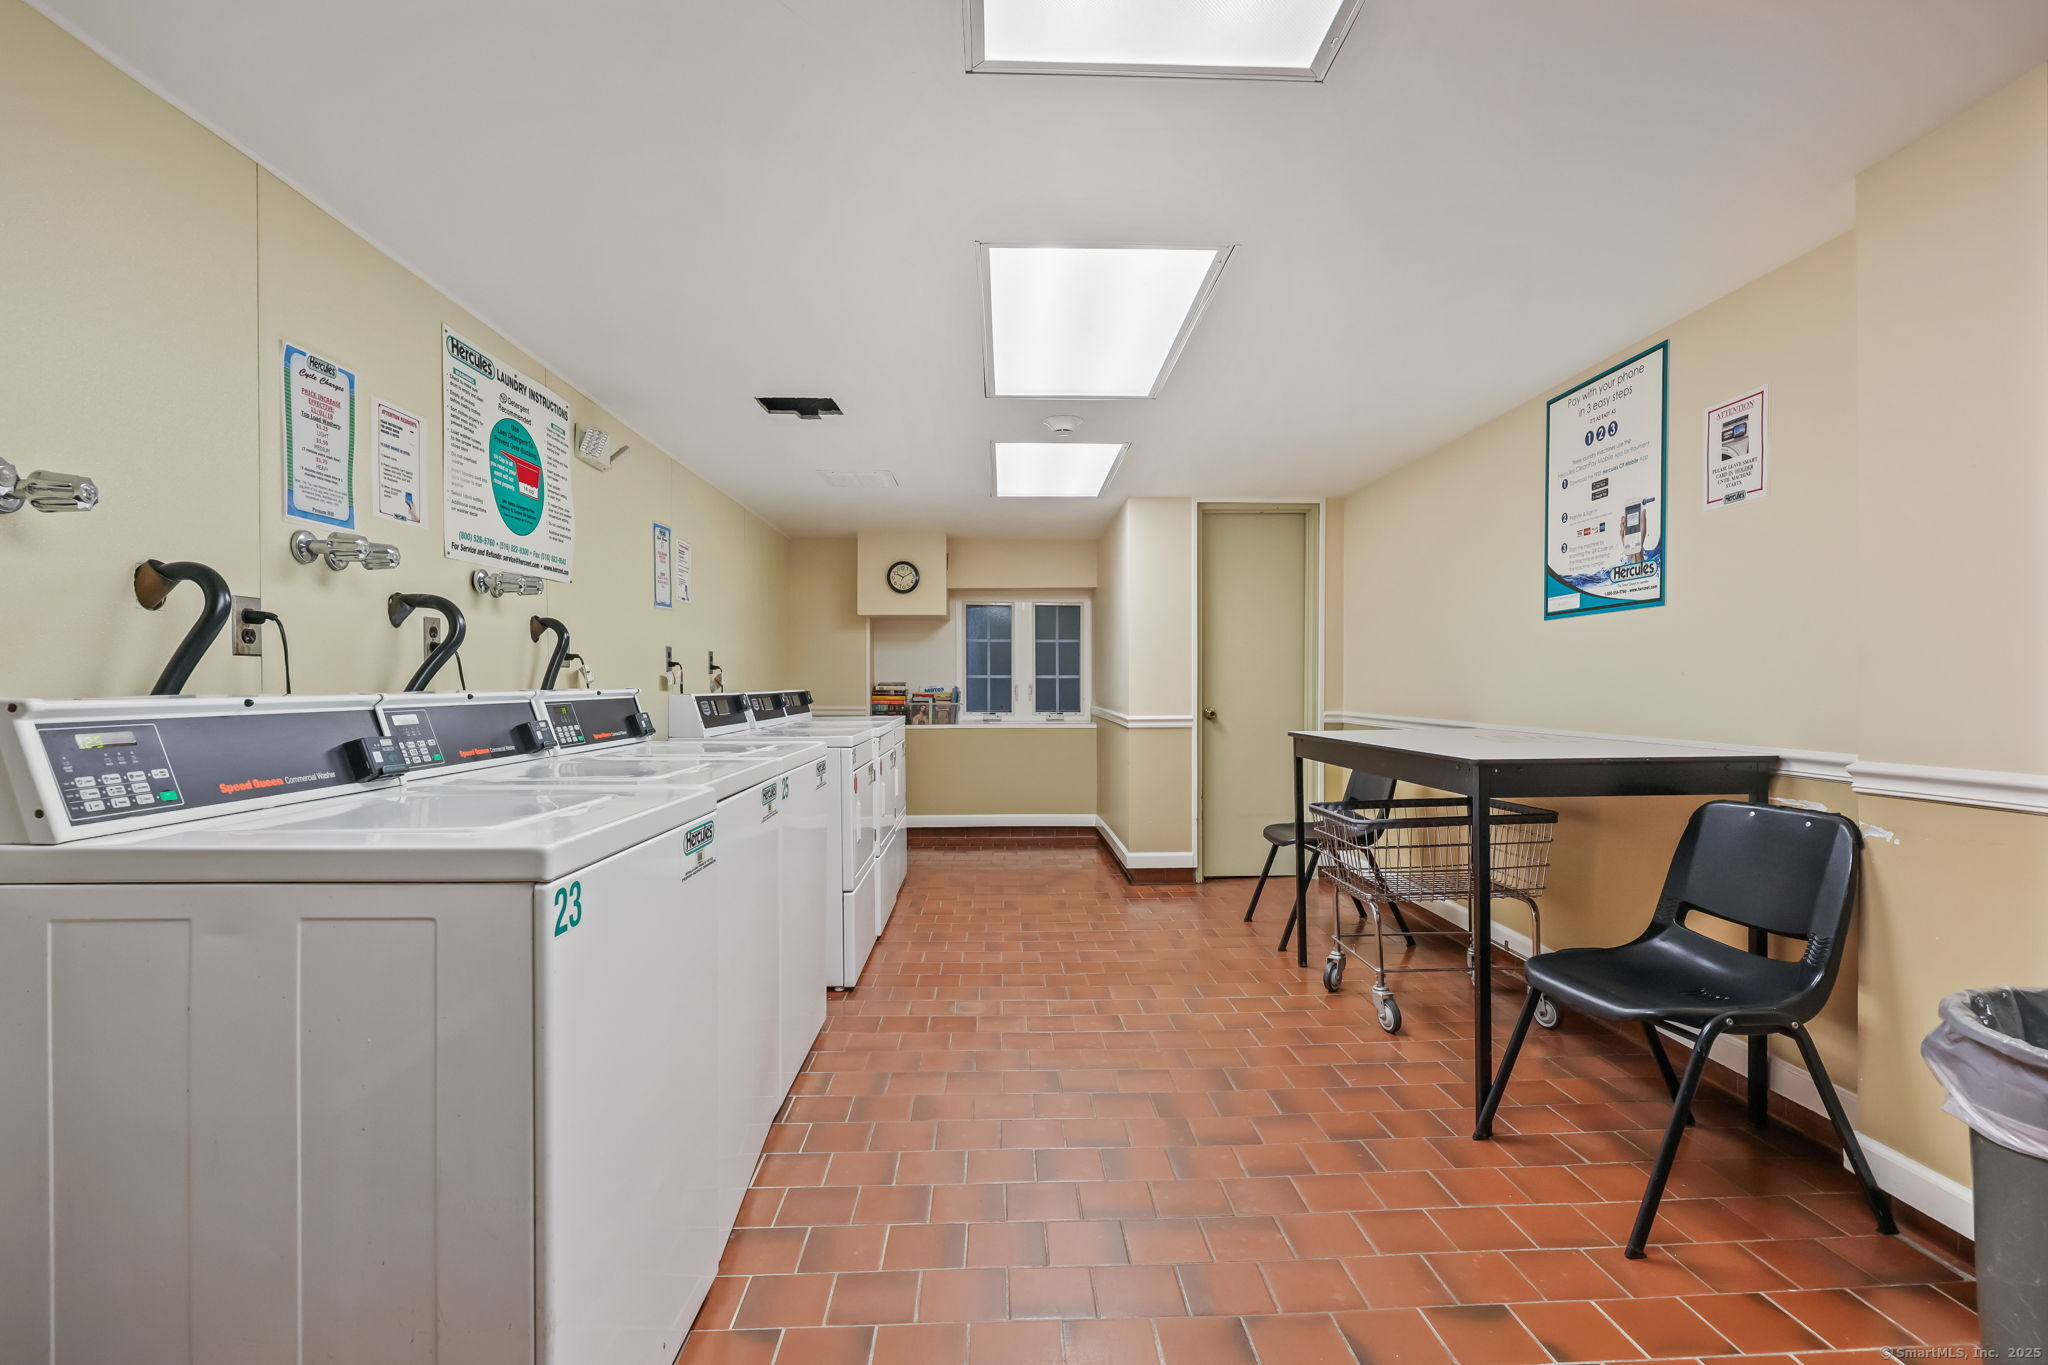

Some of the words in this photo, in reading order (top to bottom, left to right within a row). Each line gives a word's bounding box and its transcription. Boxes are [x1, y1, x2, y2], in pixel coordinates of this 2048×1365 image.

[309, 356, 335, 376] Hercules
[451, 337, 492, 375] Hercules
[299, 369, 317, 381] Cycle
[320, 377, 344, 391] Charges
[1567, 397, 1581, 408] Pay
[1582, 386, 1597, 400] with
[1598, 379, 1616, 394] your
[1617, 364, 1645, 386] phone
[302, 387, 316, 399] PRICE
[497, 369, 527, 396] LAUNDRY
[529, 388, 568, 421] INSTRUCTIONS
[1579, 408, 1585, 416] in
[1587, 404, 1592, 414] 3
[1592, 397, 1610, 411] easy
[1612, 386, 1633, 402] steps
[498, 403, 531, 426] Recommended
[508, 397, 529, 414] Detergent
[1716, 400, 1755, 421] ATTENTION
[301, 410, 309, 419] Top
[311, 414, 321, 423] Load
[316, 430, 328, 439] LIGHT
[1712, 466, 1727, 474] PLEASE
[1728, 461, 1741, 469] LEAVE
[1743, 457, 1758, 465] SMART
[1726, 480, 1742, 488] STARTS
[451, 542, 460, 551] For
[460, 544, 477, 555] Service
[1613, 561, 1655, 579] Hercules
[219, 780, 252, 794] Speed
[252, 778, 284, 788] Queen
[284, 774, 316, 784] Commercial
[316, 772, 336, 780] Washer
[782, 777, 788, 800] 25
[687, 825, 712, 850] Hercules
[555, 881, 582, 937] 23
